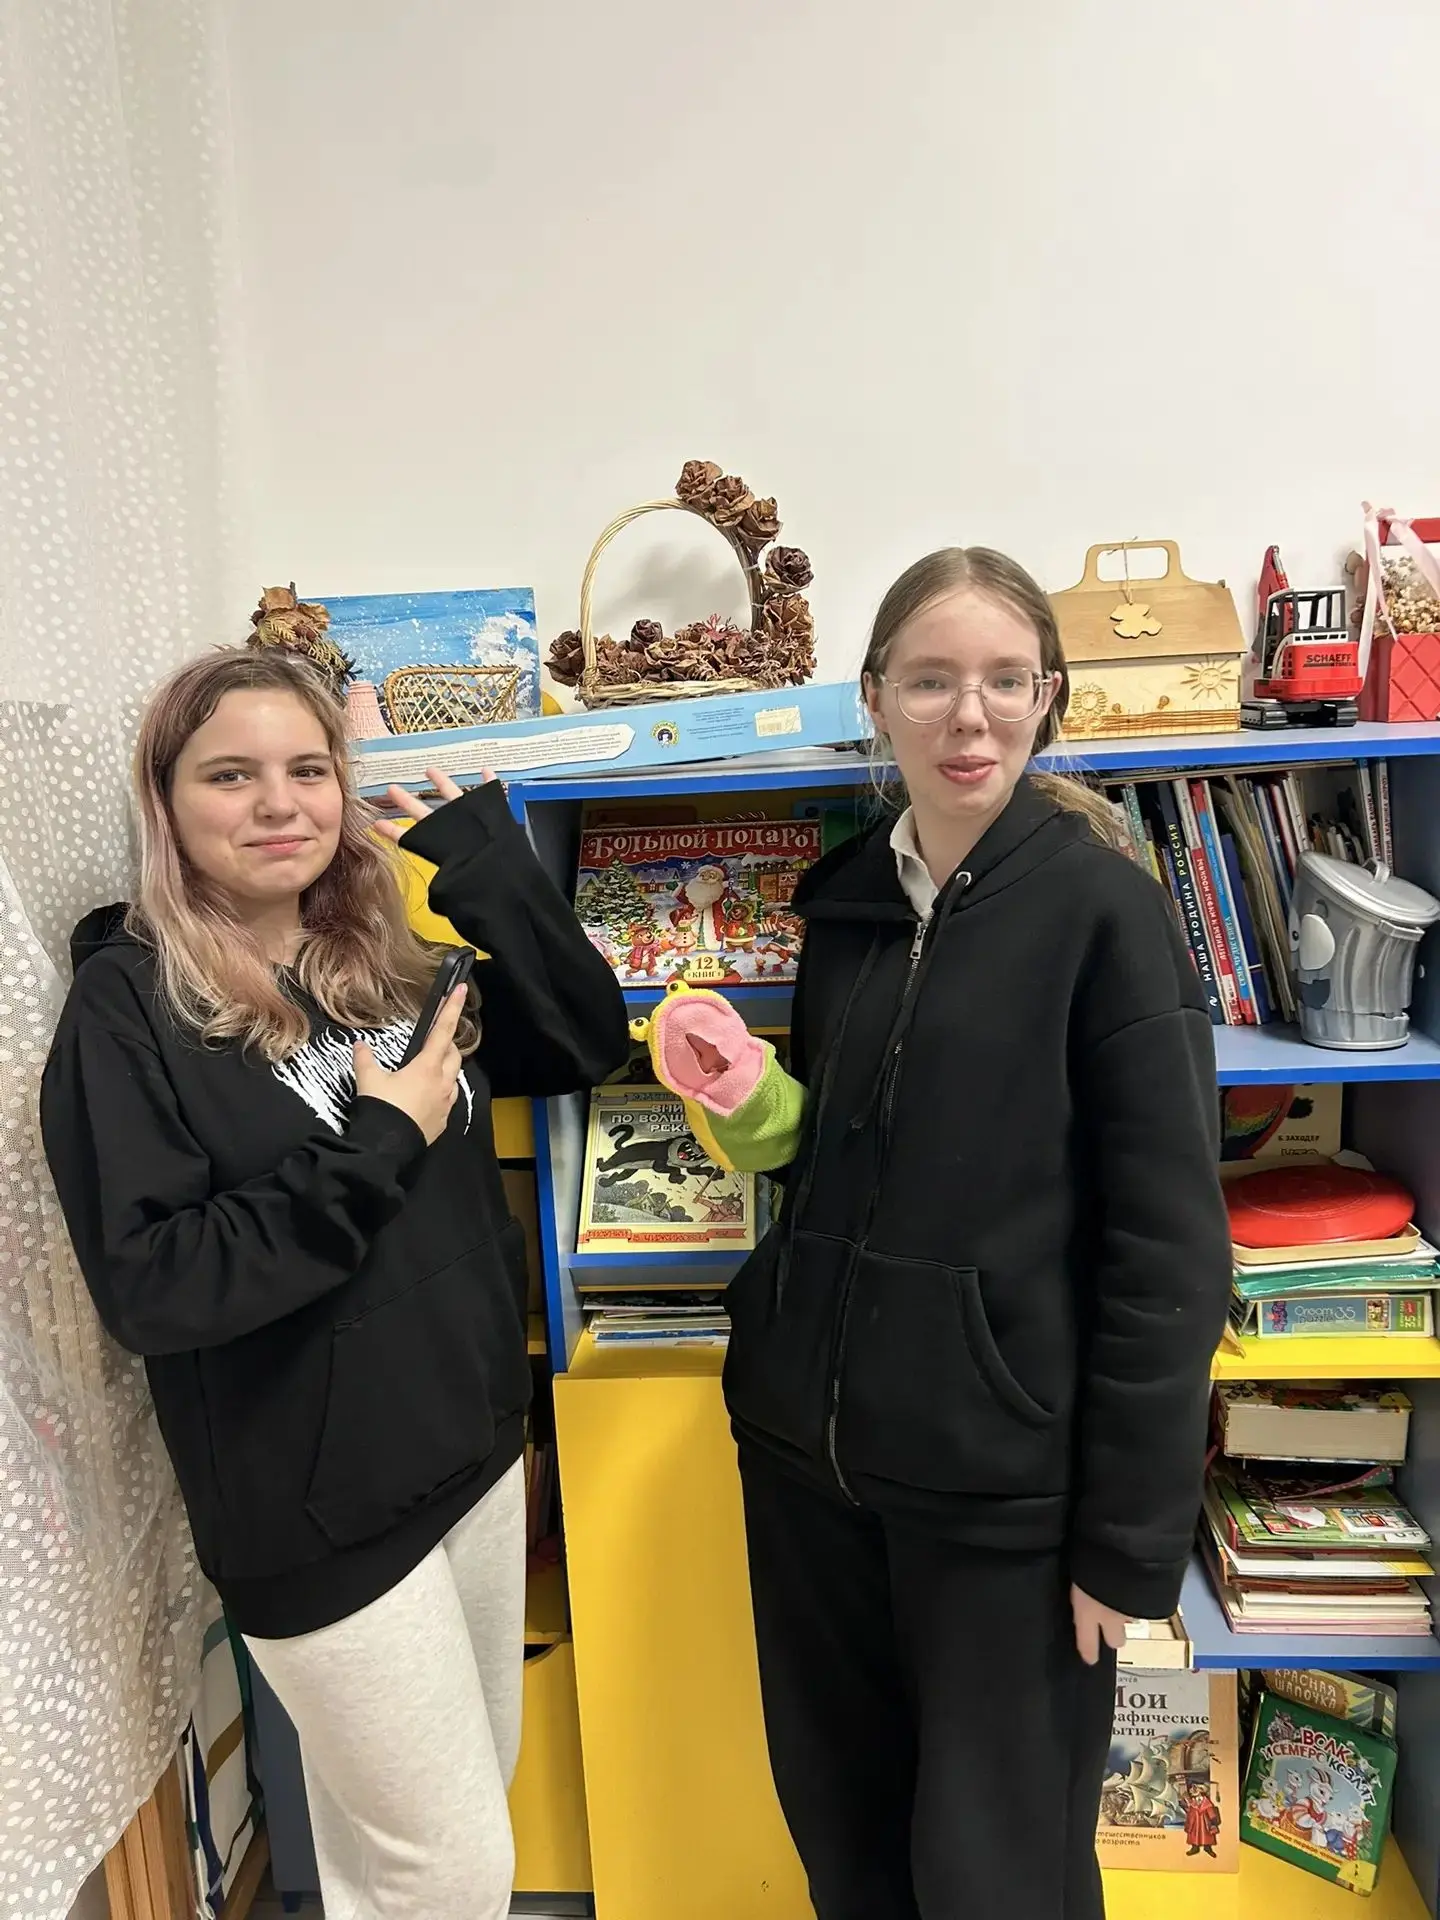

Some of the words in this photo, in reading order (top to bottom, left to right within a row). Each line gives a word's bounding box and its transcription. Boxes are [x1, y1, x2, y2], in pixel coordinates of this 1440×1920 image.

[1306, 653, 1352, 663] SCHAEFF
[588, 831, 709, 858] БОЛЬШОЙ
[1168, 823, 1185, 876] РОССИЯ
[1196, 857, 1210, 891] МОСКВЫ
[1183, 883, 1200, 937] РОДИНА
[1204, 892, 1217, 917] МИФЫ
[1213, 925, 1227, 960] ЛЕГЕНДЫ
[692, 970, 716, 978] КНИГ
[695, 956, 713, 970] 12
[1197, 943, 1212, 981] НАША
[611, 1114, 634, 1123] ПО
[639, 1113, 687, 1123] ВОЛШ
[651, 1104, 683, 1113] ВНИ
[1275, 1668, 1336, 1697] КРАСНАЯ
[1275, 1677, 1336, 1709] ШАПОЧКА
[1112, 1711, 1209, 1726] афические
[1112, 1727, 1155, 1737] ытия
[1301, 1728, 1352, 1763] ВОЛК
[1261, 1744, 1273, 1760] И
[1273, 1743, 1326, 1762] СЕМЕРО
[1328, 1757, 1376, 1805] КОЗЛЯТ
[1096, 1831, 1166, 1840] тешественников
